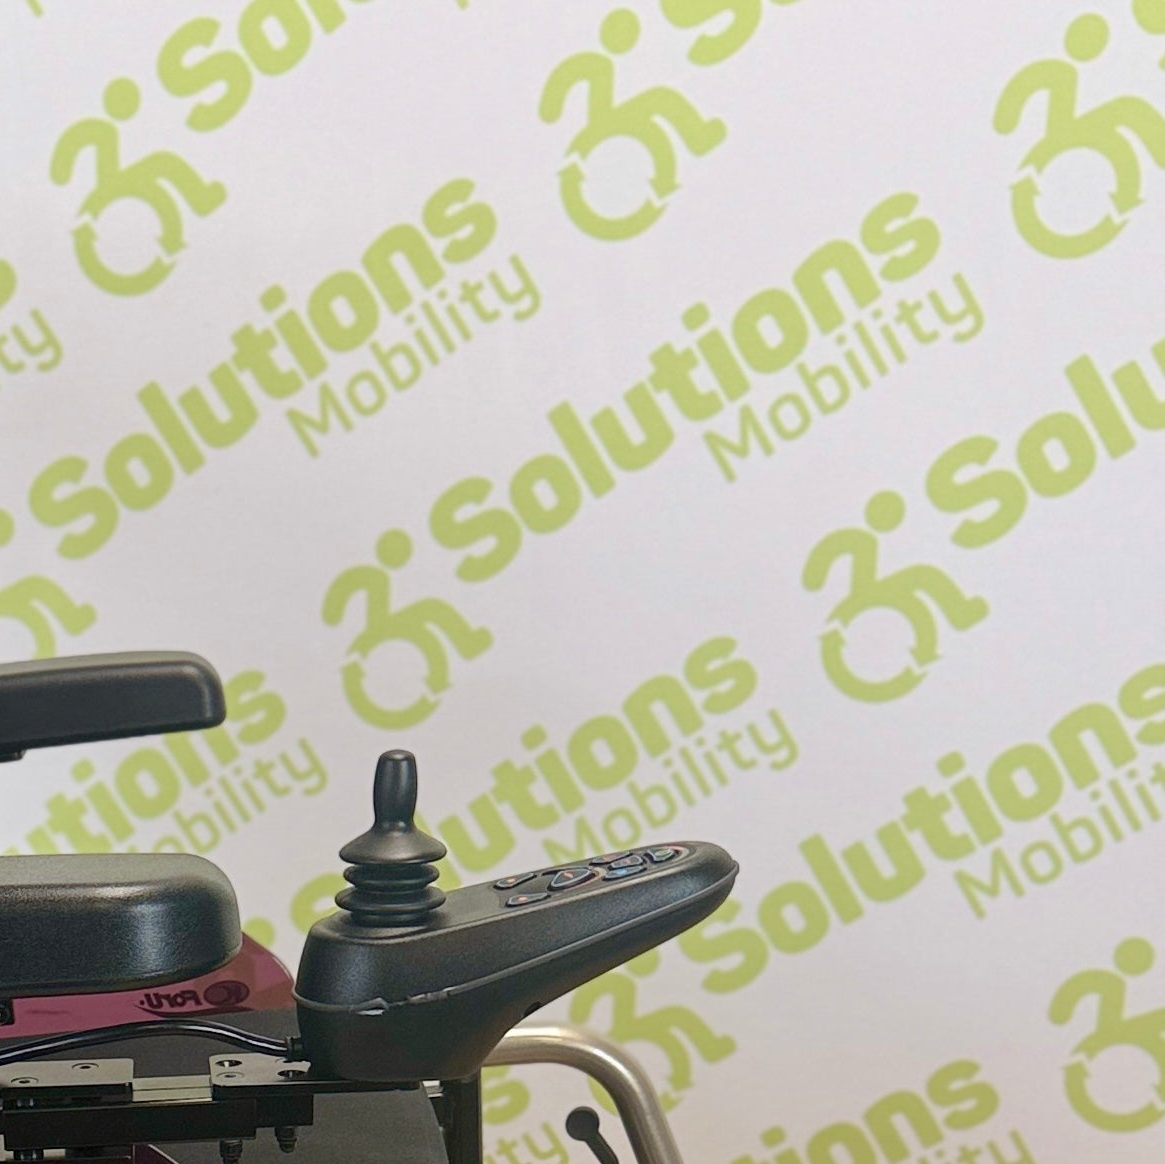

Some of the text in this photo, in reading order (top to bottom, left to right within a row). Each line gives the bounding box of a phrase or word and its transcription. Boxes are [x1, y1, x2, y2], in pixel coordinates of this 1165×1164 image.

[28, 177, 498, 561] Solutions
[286, 253, 542, 459] Mobility
[428, 191, 942, 583] Solutions
[702, 271, 985, 484] Mobility
